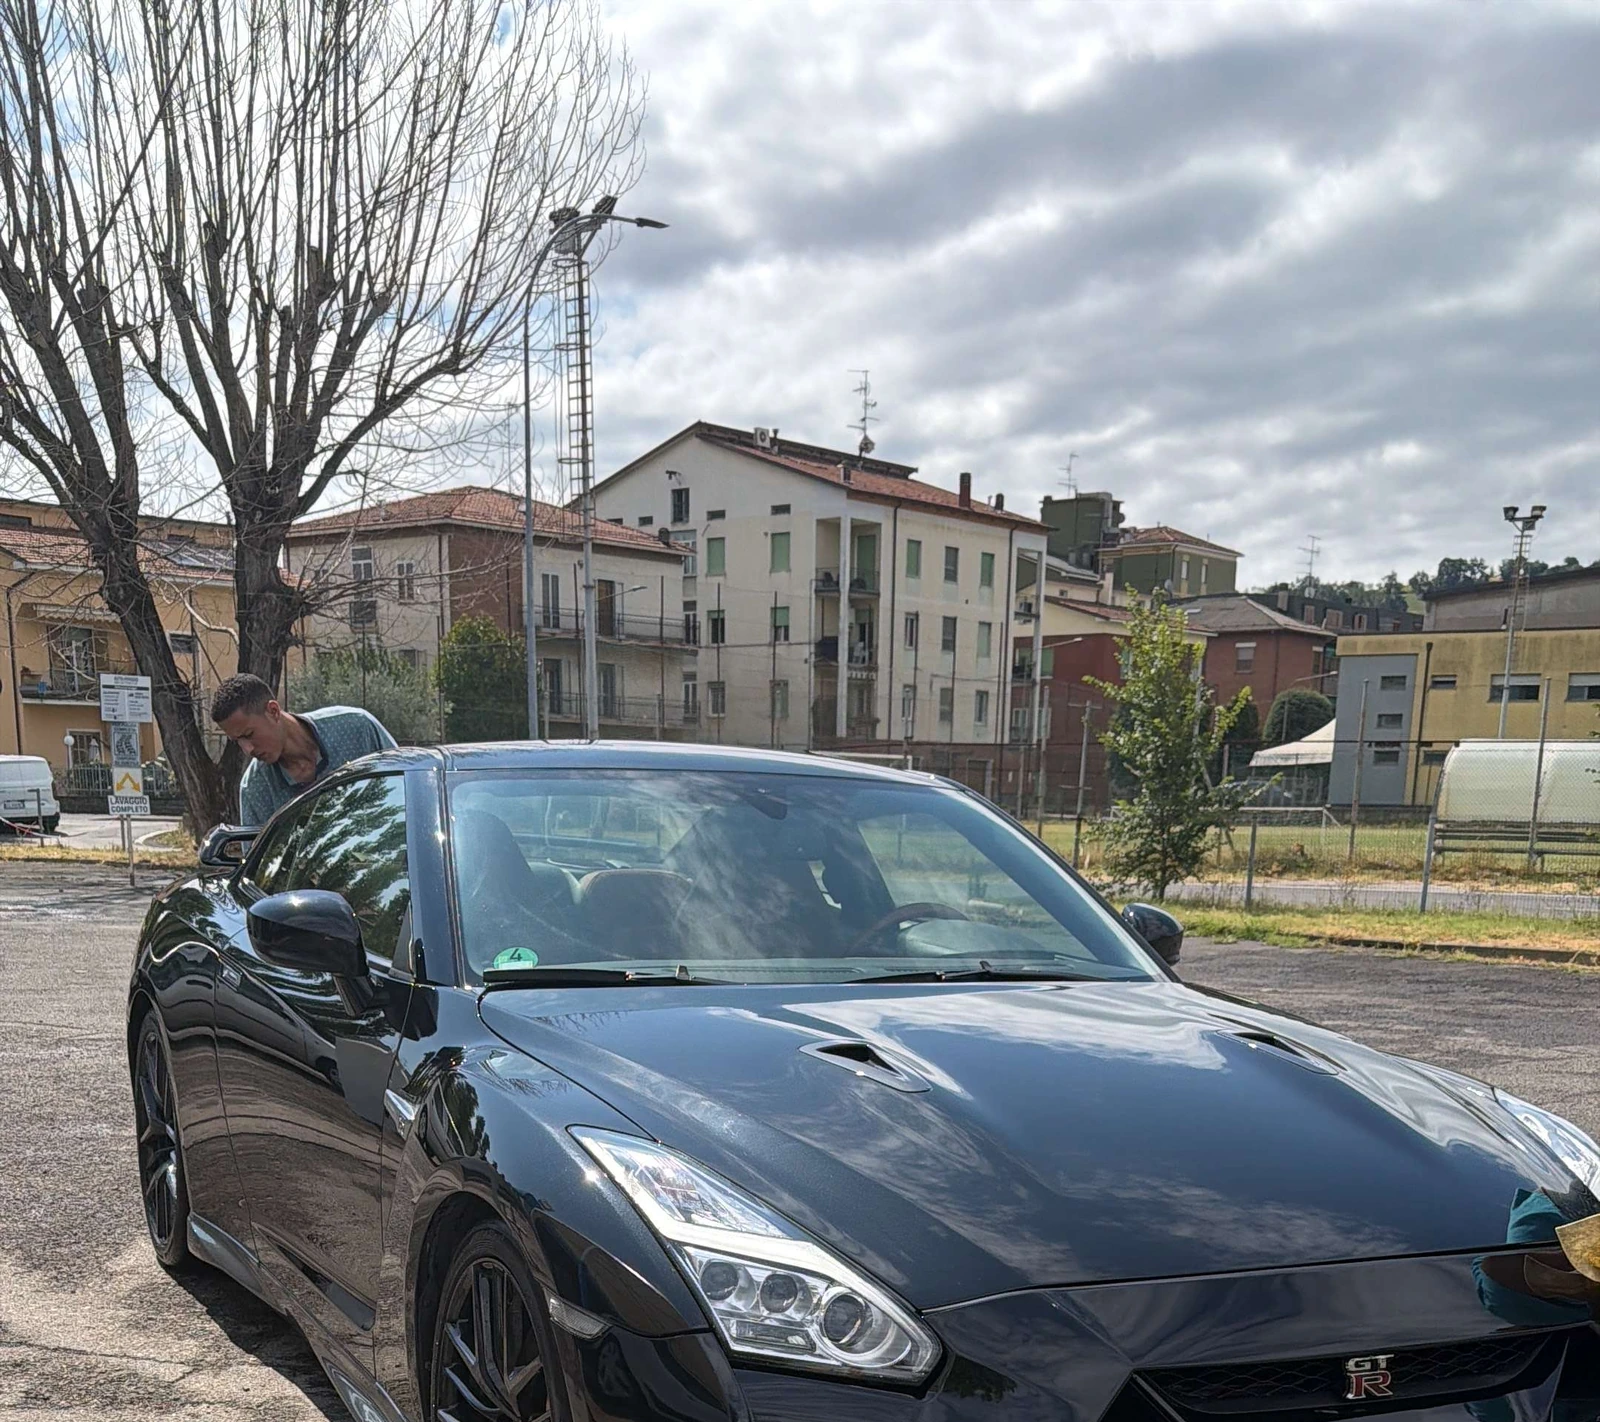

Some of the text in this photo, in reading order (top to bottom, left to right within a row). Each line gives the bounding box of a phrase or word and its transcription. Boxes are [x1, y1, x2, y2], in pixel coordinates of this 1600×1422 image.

[110, 796, 148, 805] LAVAGGIO
[111, 805, 148, 813] COMPLETO
[509, 948, 523, 961] 4
[1345, 1354, 1394, 1371] GT
[1346, 1371, 1393, 1399] R
